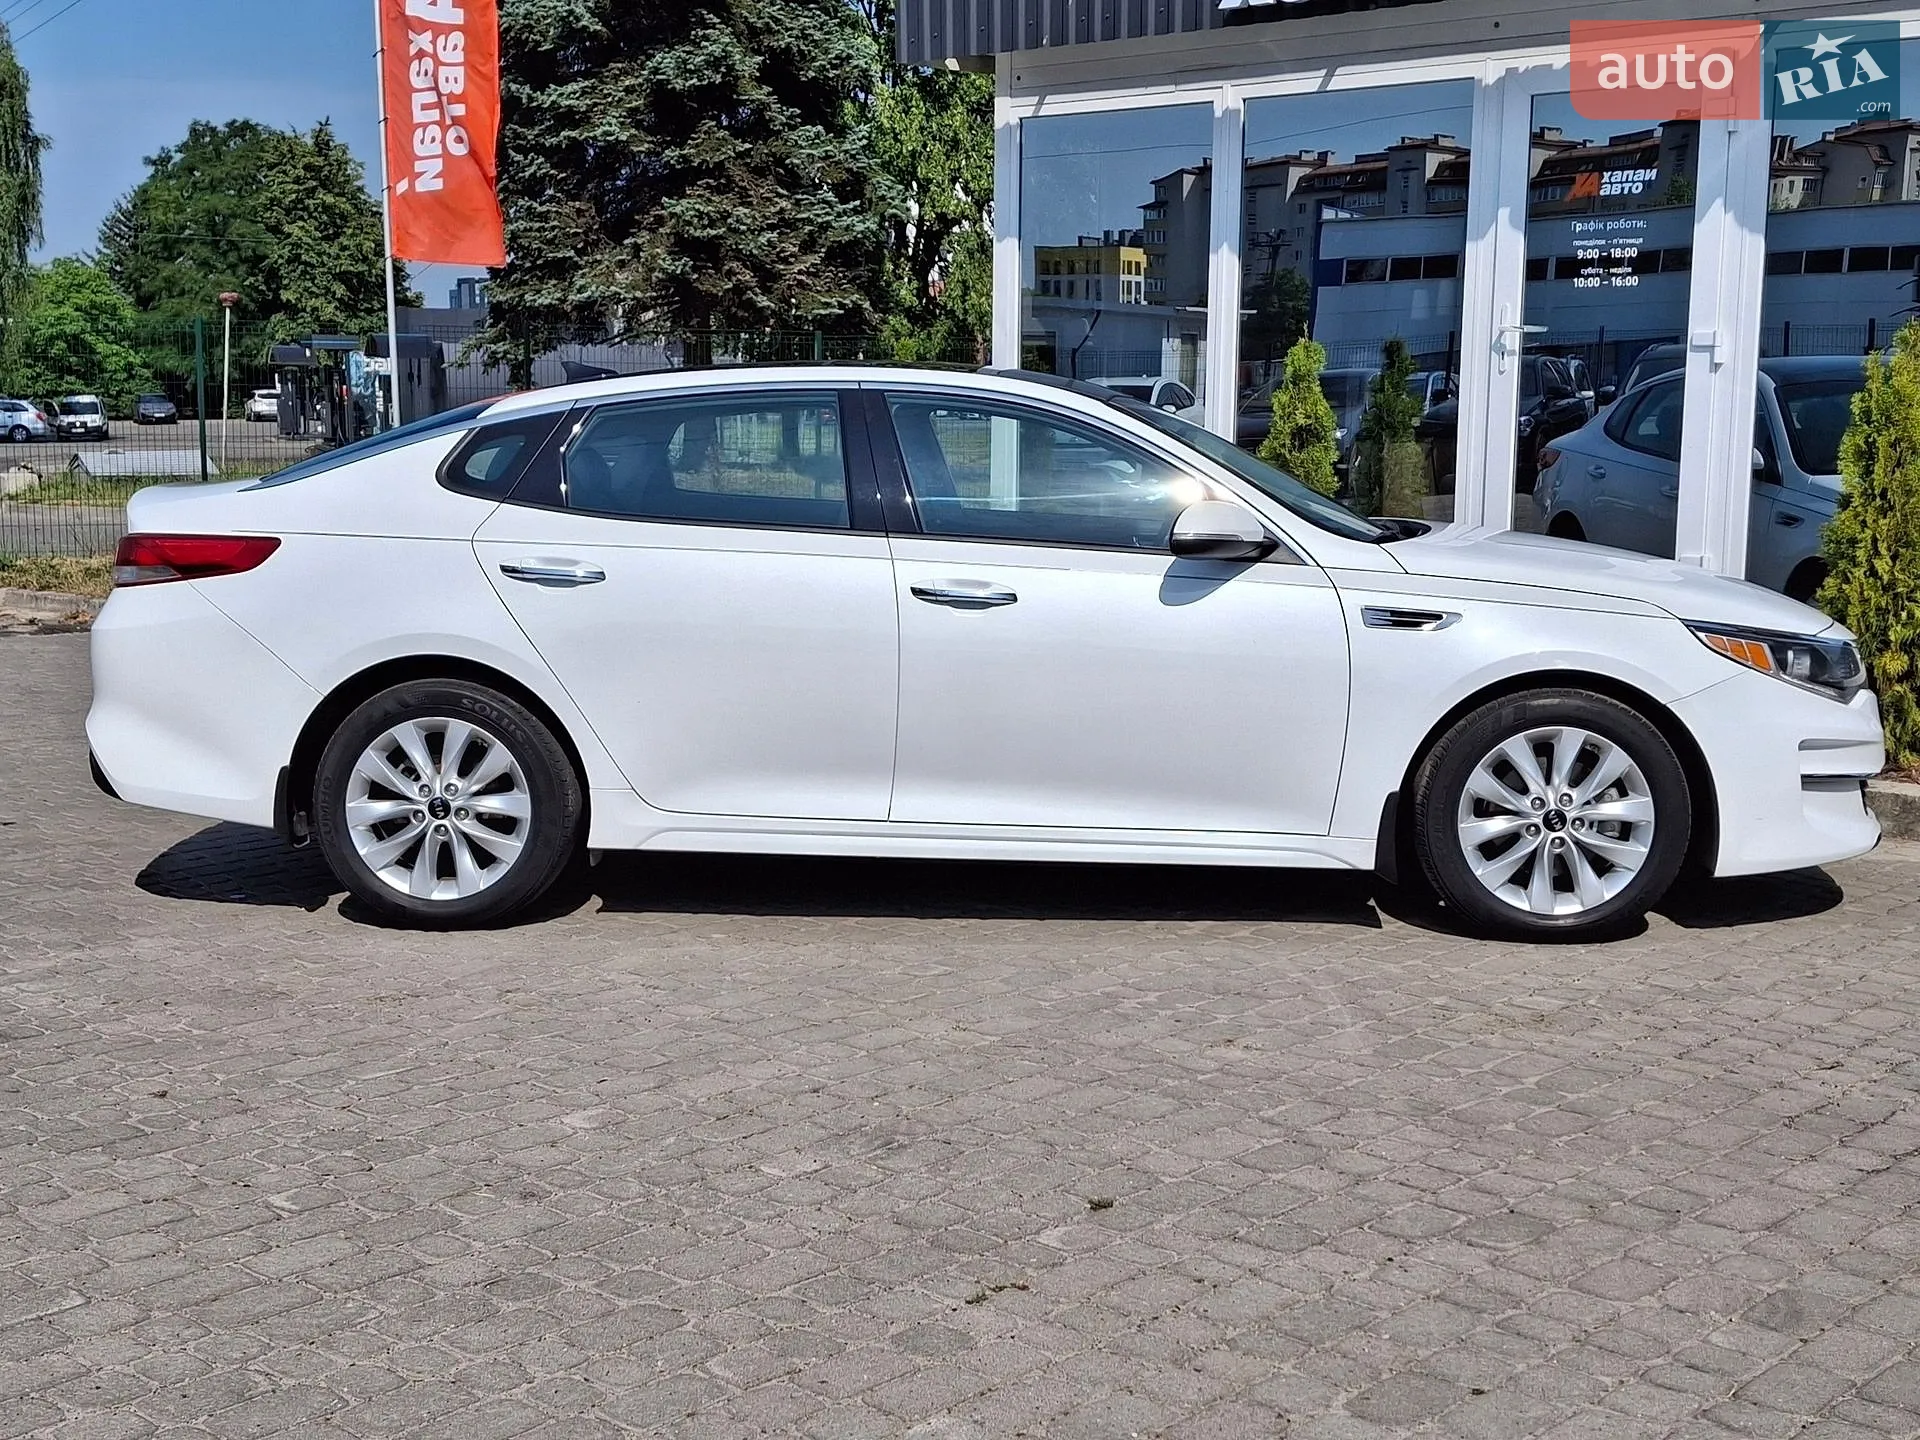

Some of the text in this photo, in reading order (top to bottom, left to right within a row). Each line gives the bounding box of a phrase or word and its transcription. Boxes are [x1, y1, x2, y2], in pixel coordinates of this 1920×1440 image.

[1600, 182, 1643, 196] авто
[1571, 218, 1647, 233] Графік роботи:
[1577, 249, 1599, 259] 9:00
[1610, 247, 1638, 258] 18:00
[1573, 277, 1600, 288] 10:00
[1611, 276, 1639, 287] 16:00
[432, 799, 445, 819] KIA
[1548, 810, 1563, 831] KIA
